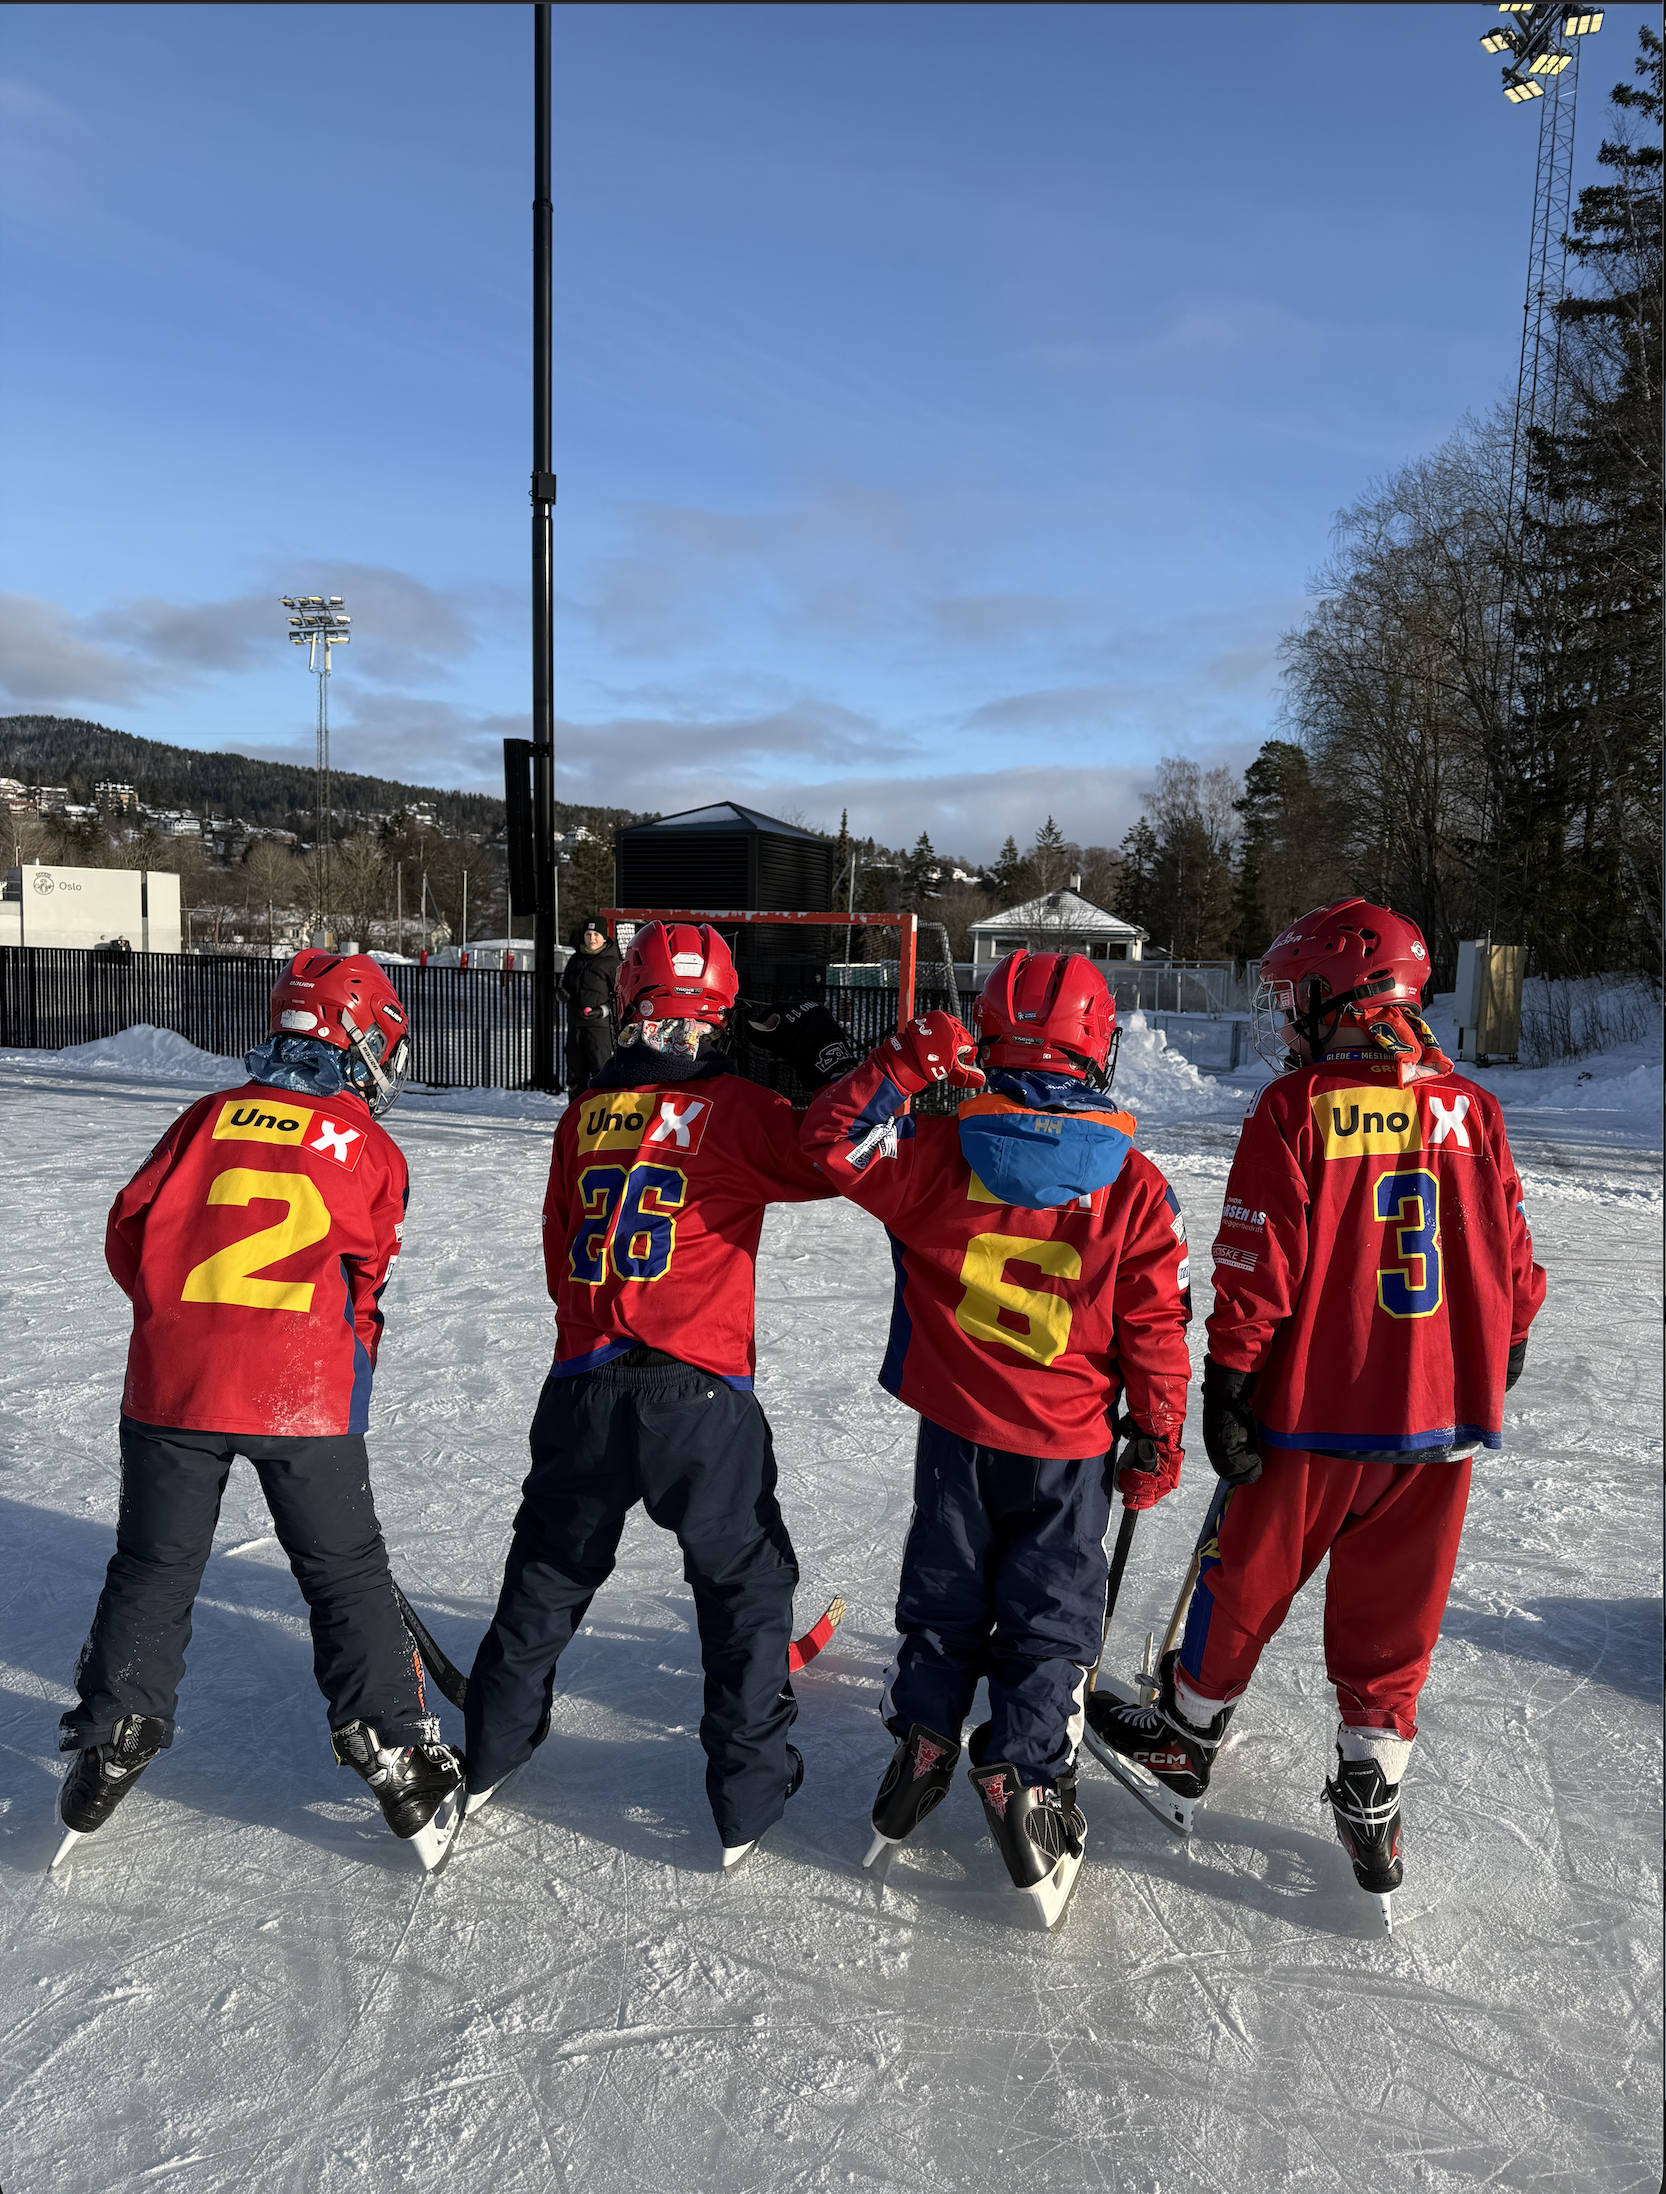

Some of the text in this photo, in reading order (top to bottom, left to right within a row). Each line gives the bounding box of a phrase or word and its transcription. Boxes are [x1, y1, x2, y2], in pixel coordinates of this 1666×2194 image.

[59, 881, 82, 891] Oslo
[289, 980, 315, 988] BAUER
[382, 1004, 403, 1022] BAUER
[362, 1046, 378, 1071] BAUER
[1326, 1052, 1350, 1061] GLEDE
[586, 1101, 705, 1148] Uno X
[1034, 1118, 1063, 1135] HH
[1332, 1095, 1470, 1148] Uno X
[230, 1108, 361, 1163] Uno X
[568, 1160, 688, 1286] 26
[1223, 1204, 1267, 1225] RSEN AS
[180, 1167, 331, 1313] 2
[1373, 1168, 1443, 1319] 3
[955, 1232, 1082, 1367] 6
[1133, 1751, 1187, 1765] CCM
